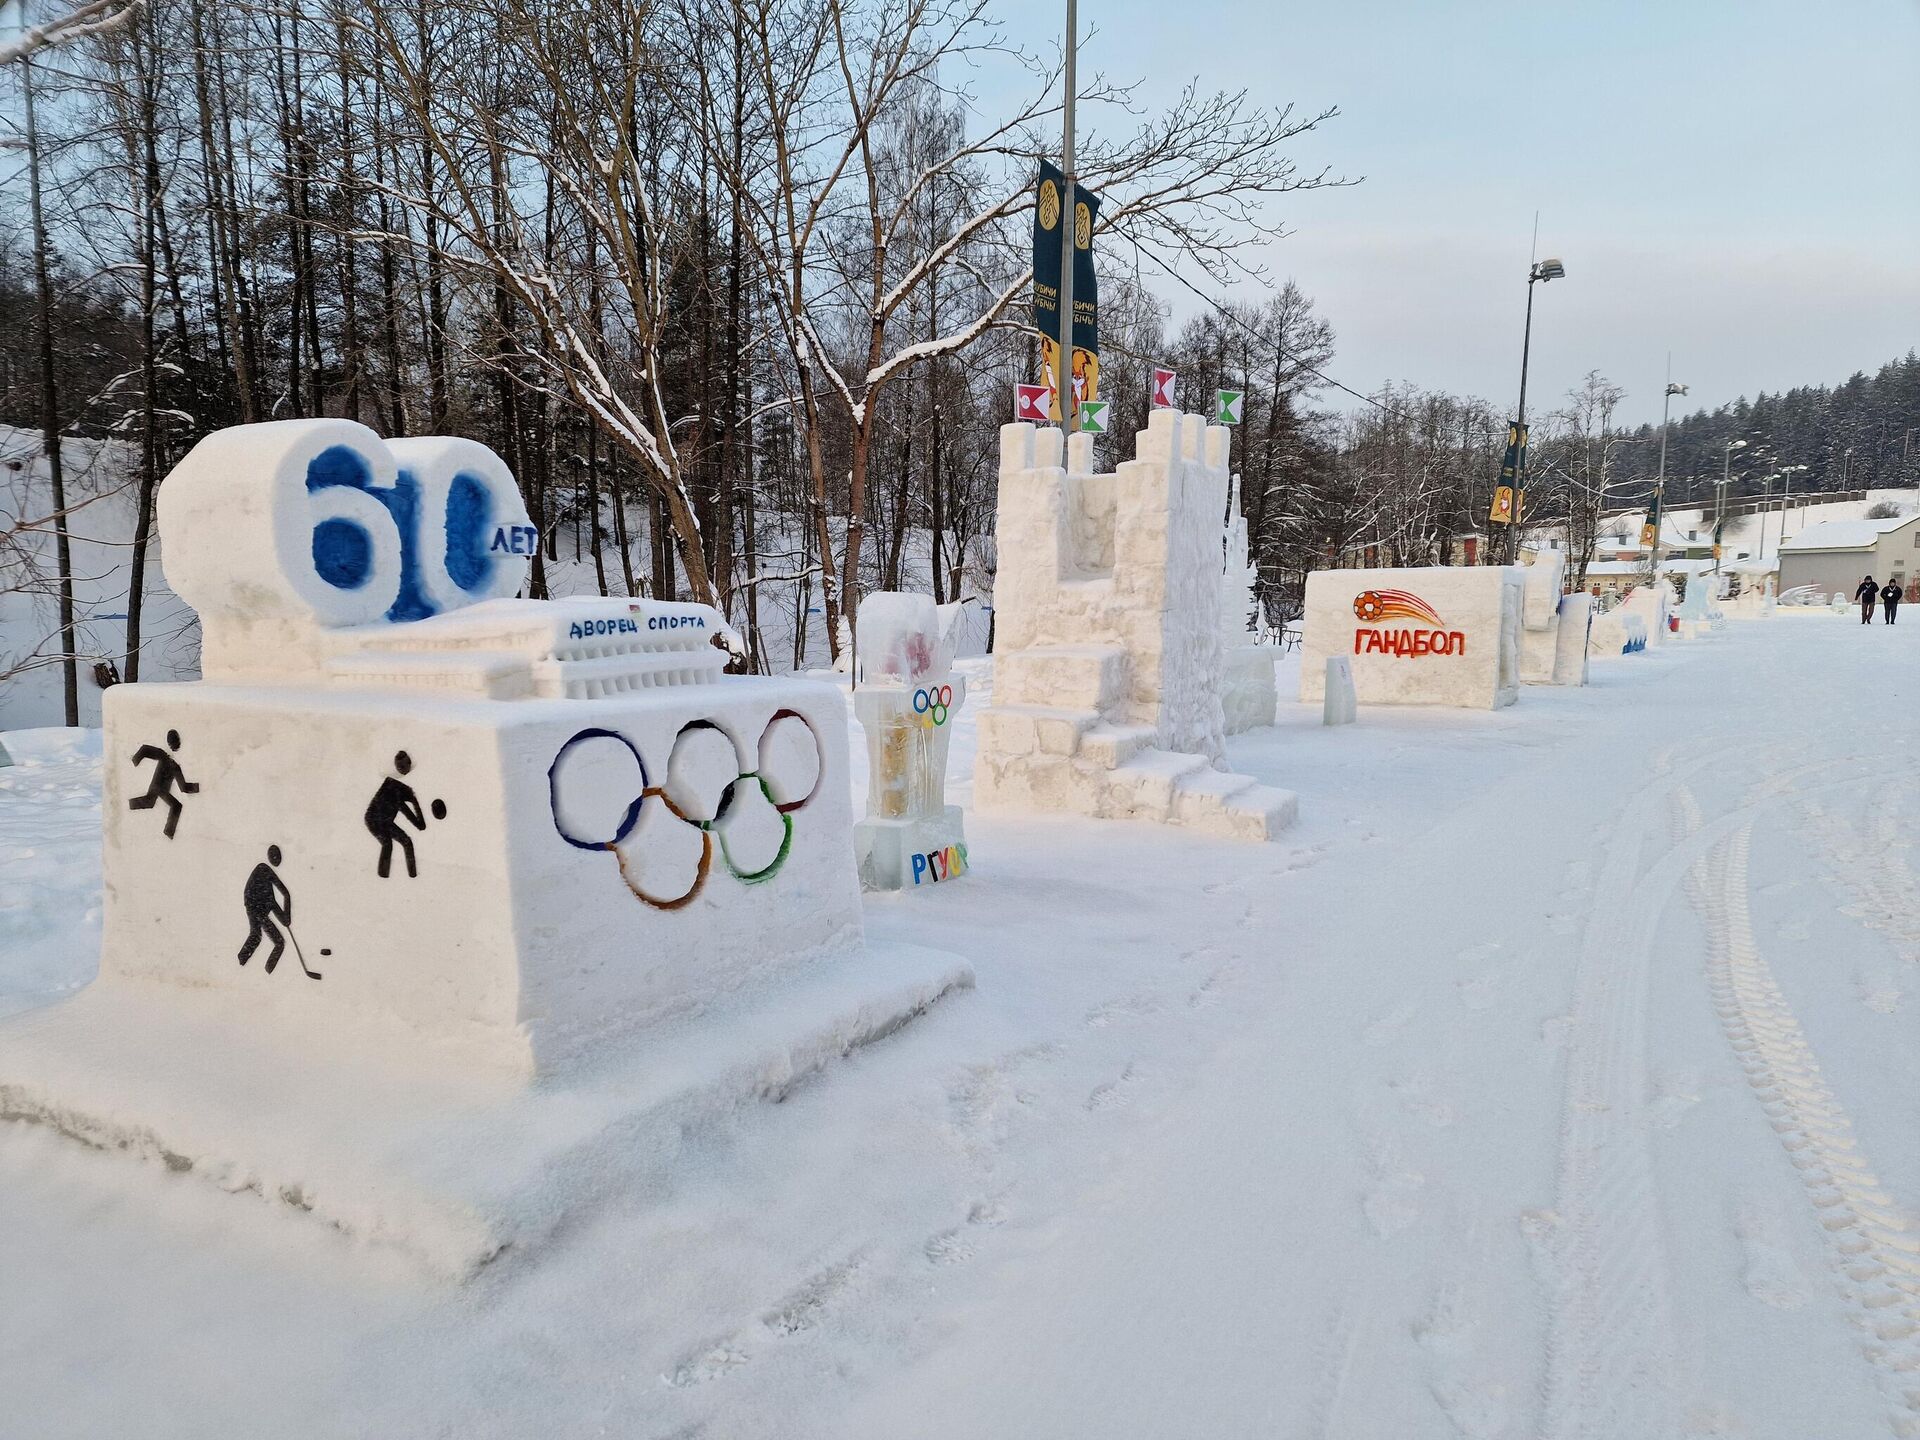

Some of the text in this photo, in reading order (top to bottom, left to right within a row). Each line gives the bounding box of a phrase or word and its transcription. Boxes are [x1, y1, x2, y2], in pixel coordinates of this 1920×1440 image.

[275, 418, 538, 627] 60 ЛЕТ
[569, 616, 705, 640] ДВОРЕЦ СПОРТА
[1354, 628, 1466, 659] ГАНДБОЛ
